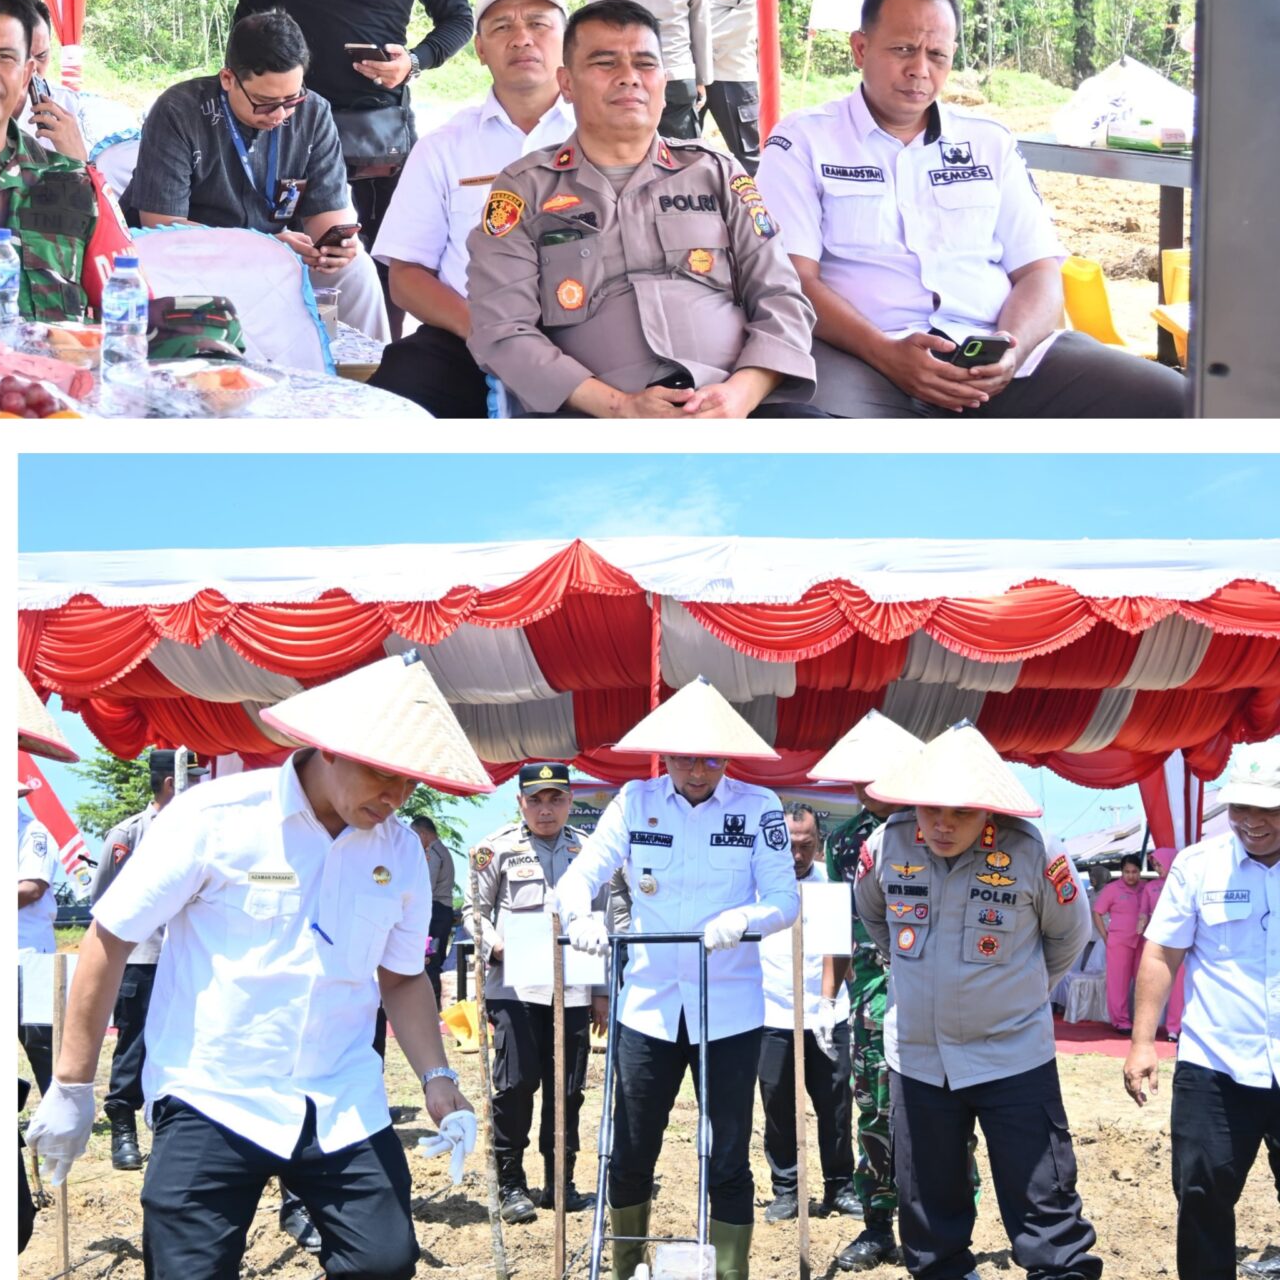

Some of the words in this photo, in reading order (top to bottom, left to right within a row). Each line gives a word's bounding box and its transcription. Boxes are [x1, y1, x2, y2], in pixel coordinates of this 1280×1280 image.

[933, 169, 988, 182] PEMDES
[659, 194, 718, 212] POLRI
[715, 834, 752, 846] BUPATI
[970, 888, 1017, 905] POLRI
